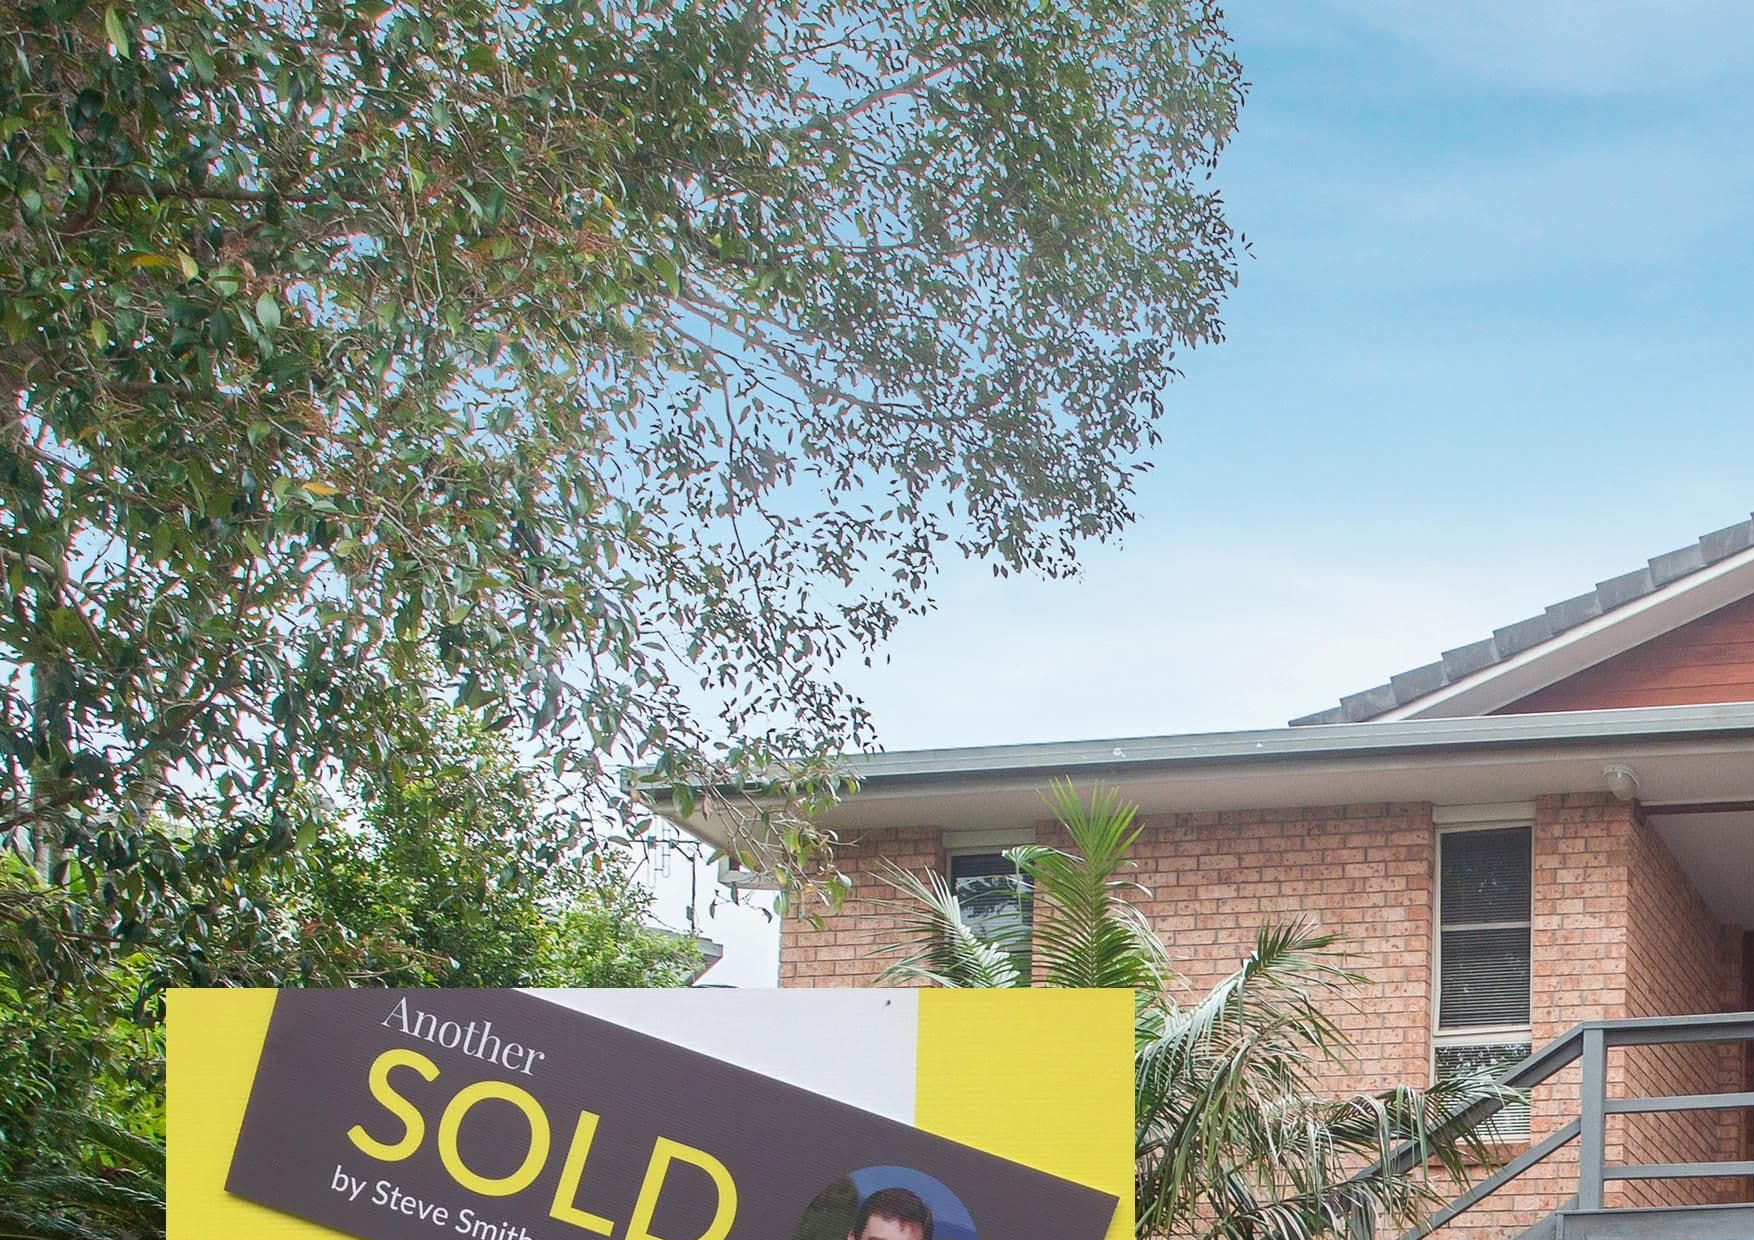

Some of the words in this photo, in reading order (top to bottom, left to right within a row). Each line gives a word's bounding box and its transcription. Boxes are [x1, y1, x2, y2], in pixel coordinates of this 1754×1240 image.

[381, 996, 545, 1076] Another
[331, 1165, 367, 1200] by
[372, 1180, 448, 1226] Steve
